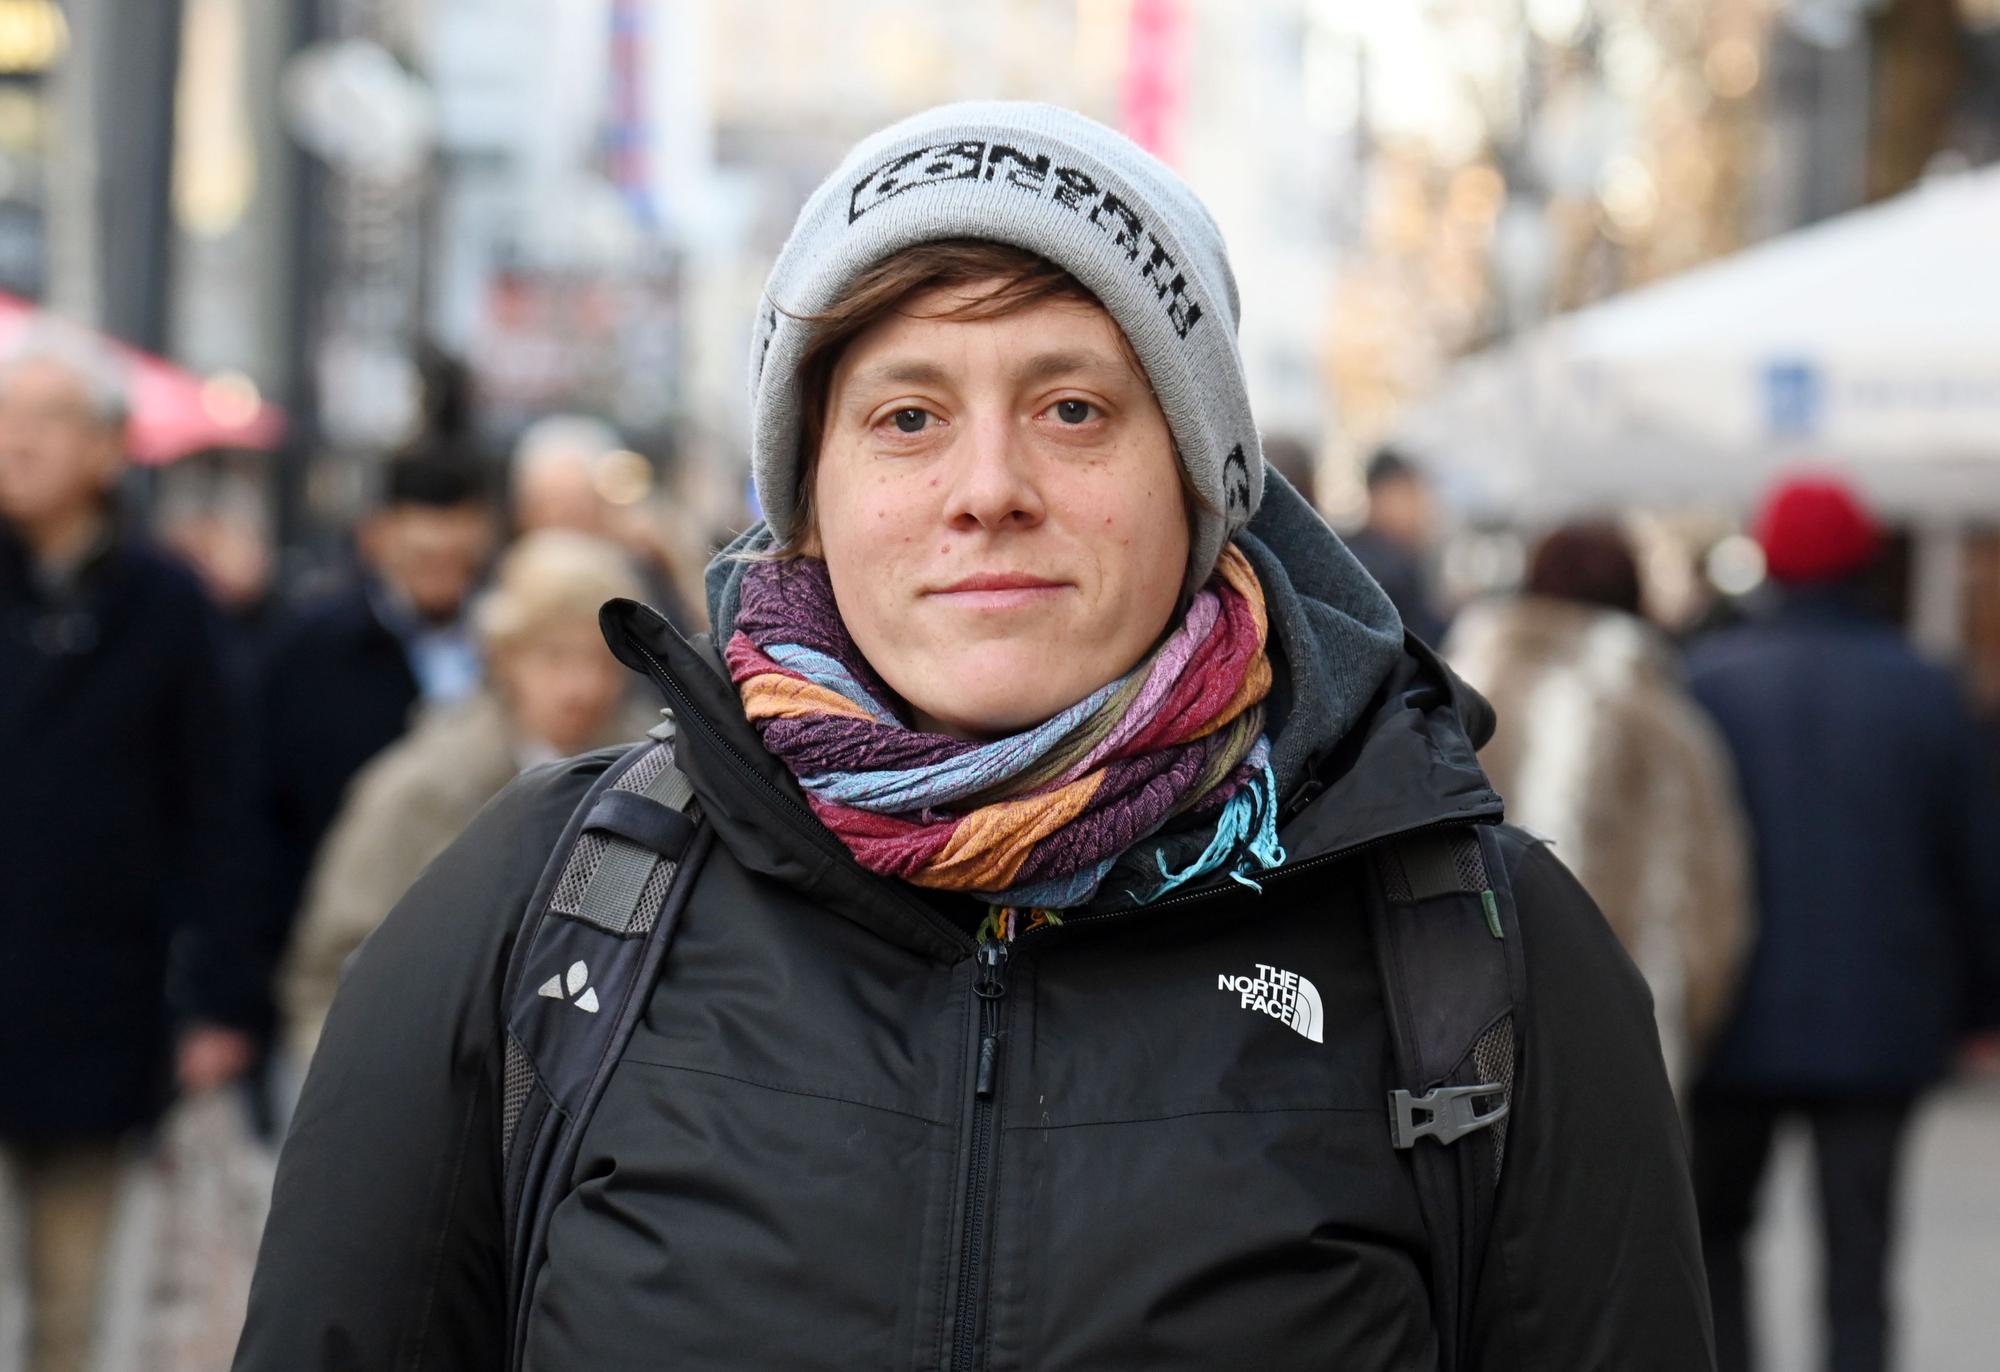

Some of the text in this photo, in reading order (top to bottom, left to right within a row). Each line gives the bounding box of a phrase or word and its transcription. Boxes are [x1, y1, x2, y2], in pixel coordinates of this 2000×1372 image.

[1218, 974, 1296, 1007] NORTH
[1255, 963, 1298, 991] THE
[1241, 992, 1294, 1026] FACE
